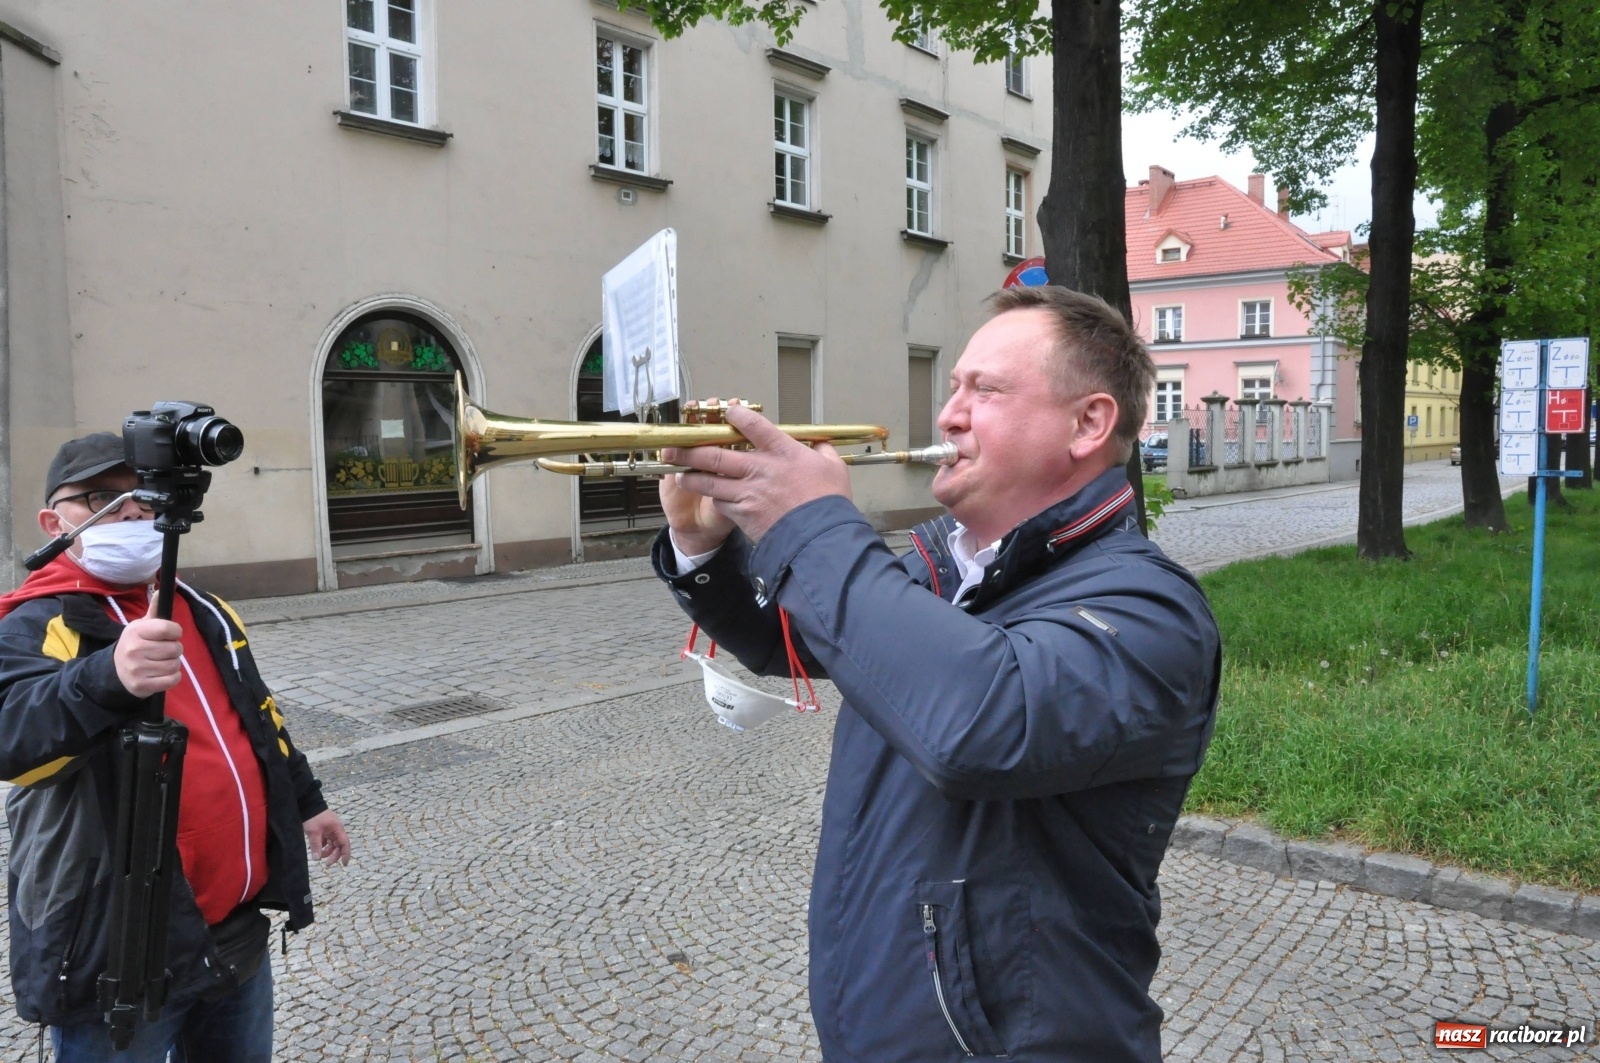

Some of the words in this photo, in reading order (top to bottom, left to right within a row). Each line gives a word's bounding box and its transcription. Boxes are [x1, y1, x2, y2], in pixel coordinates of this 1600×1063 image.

[1506, 349, 1515, 362] Z
[1552, 347, 1562, 360] Z
[1505, 392, 1514, 405] Z
[1549, 391, 1560, 404] H
[1504, 435, 1513, 448] Z
